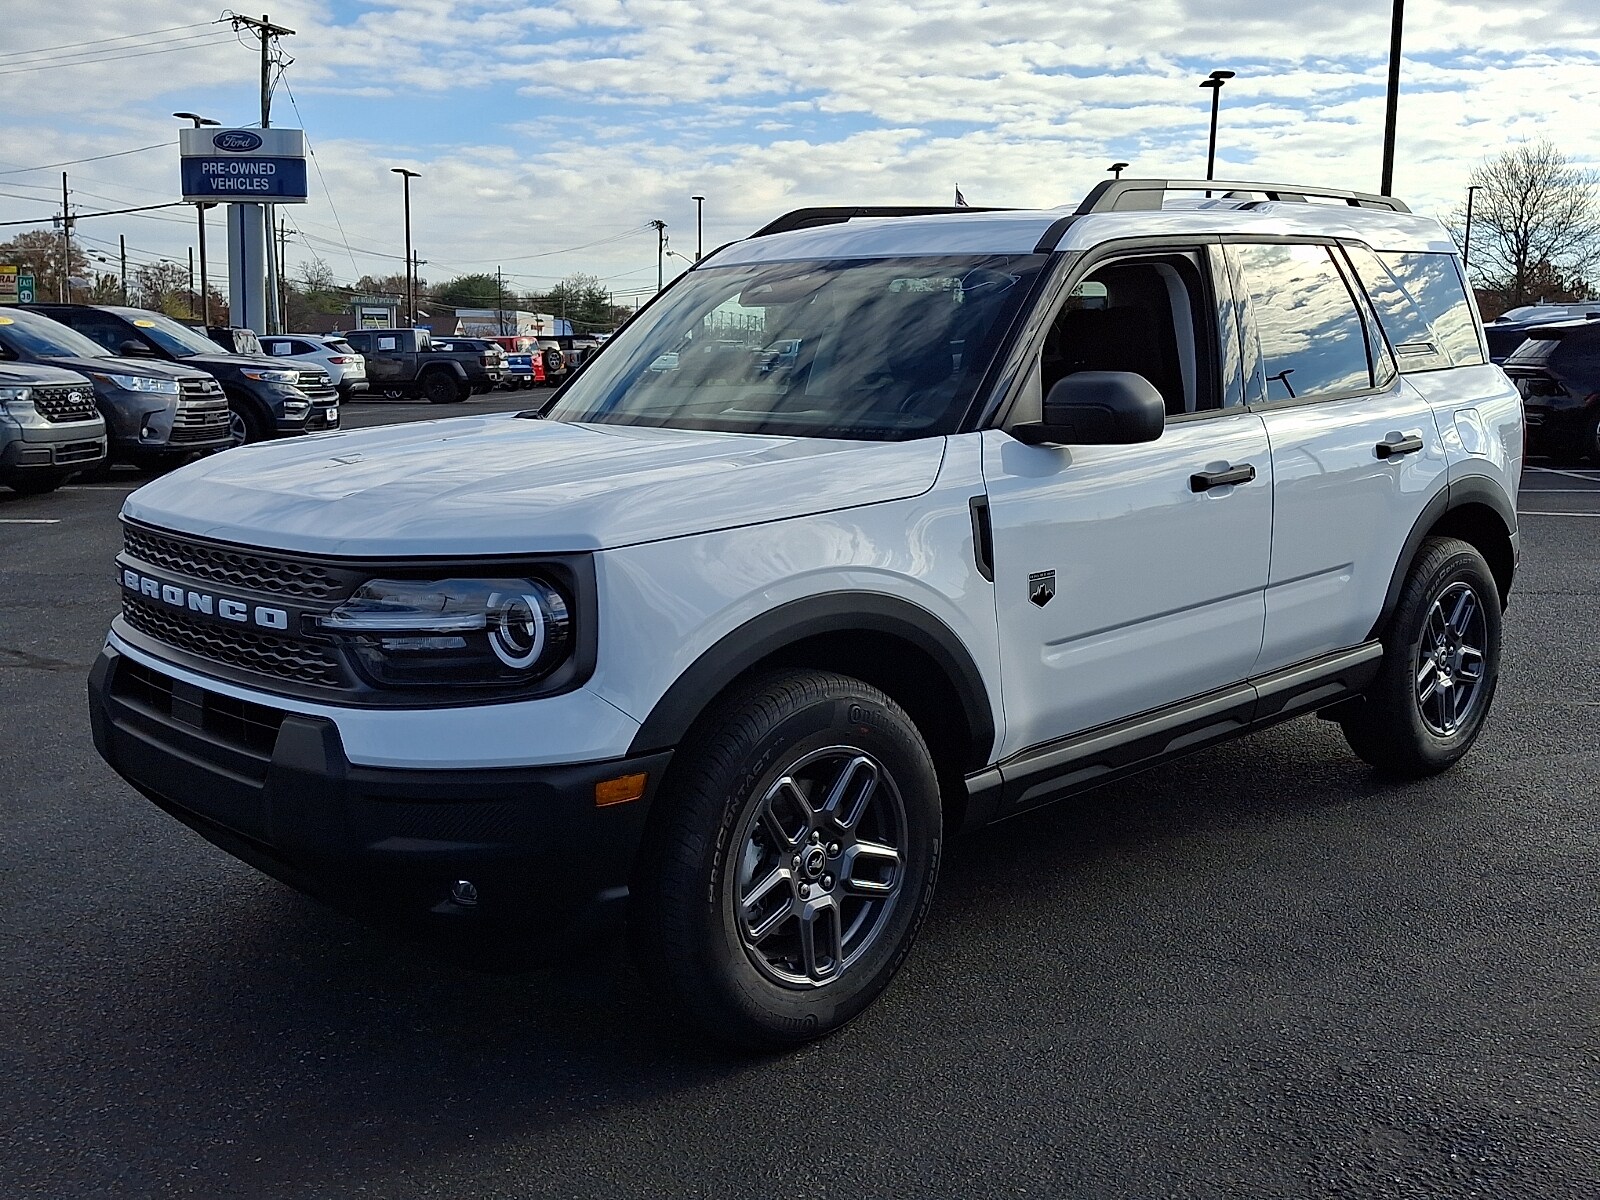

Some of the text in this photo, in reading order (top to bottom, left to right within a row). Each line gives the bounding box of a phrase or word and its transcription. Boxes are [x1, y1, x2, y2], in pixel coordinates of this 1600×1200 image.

[222, 134, 251, 148] Ford
[201, 162, 276, 175] PRE-OWNED
[210, 178, 269, 190] VEHICLES
[124, 569, 288, 630] BRONCO
